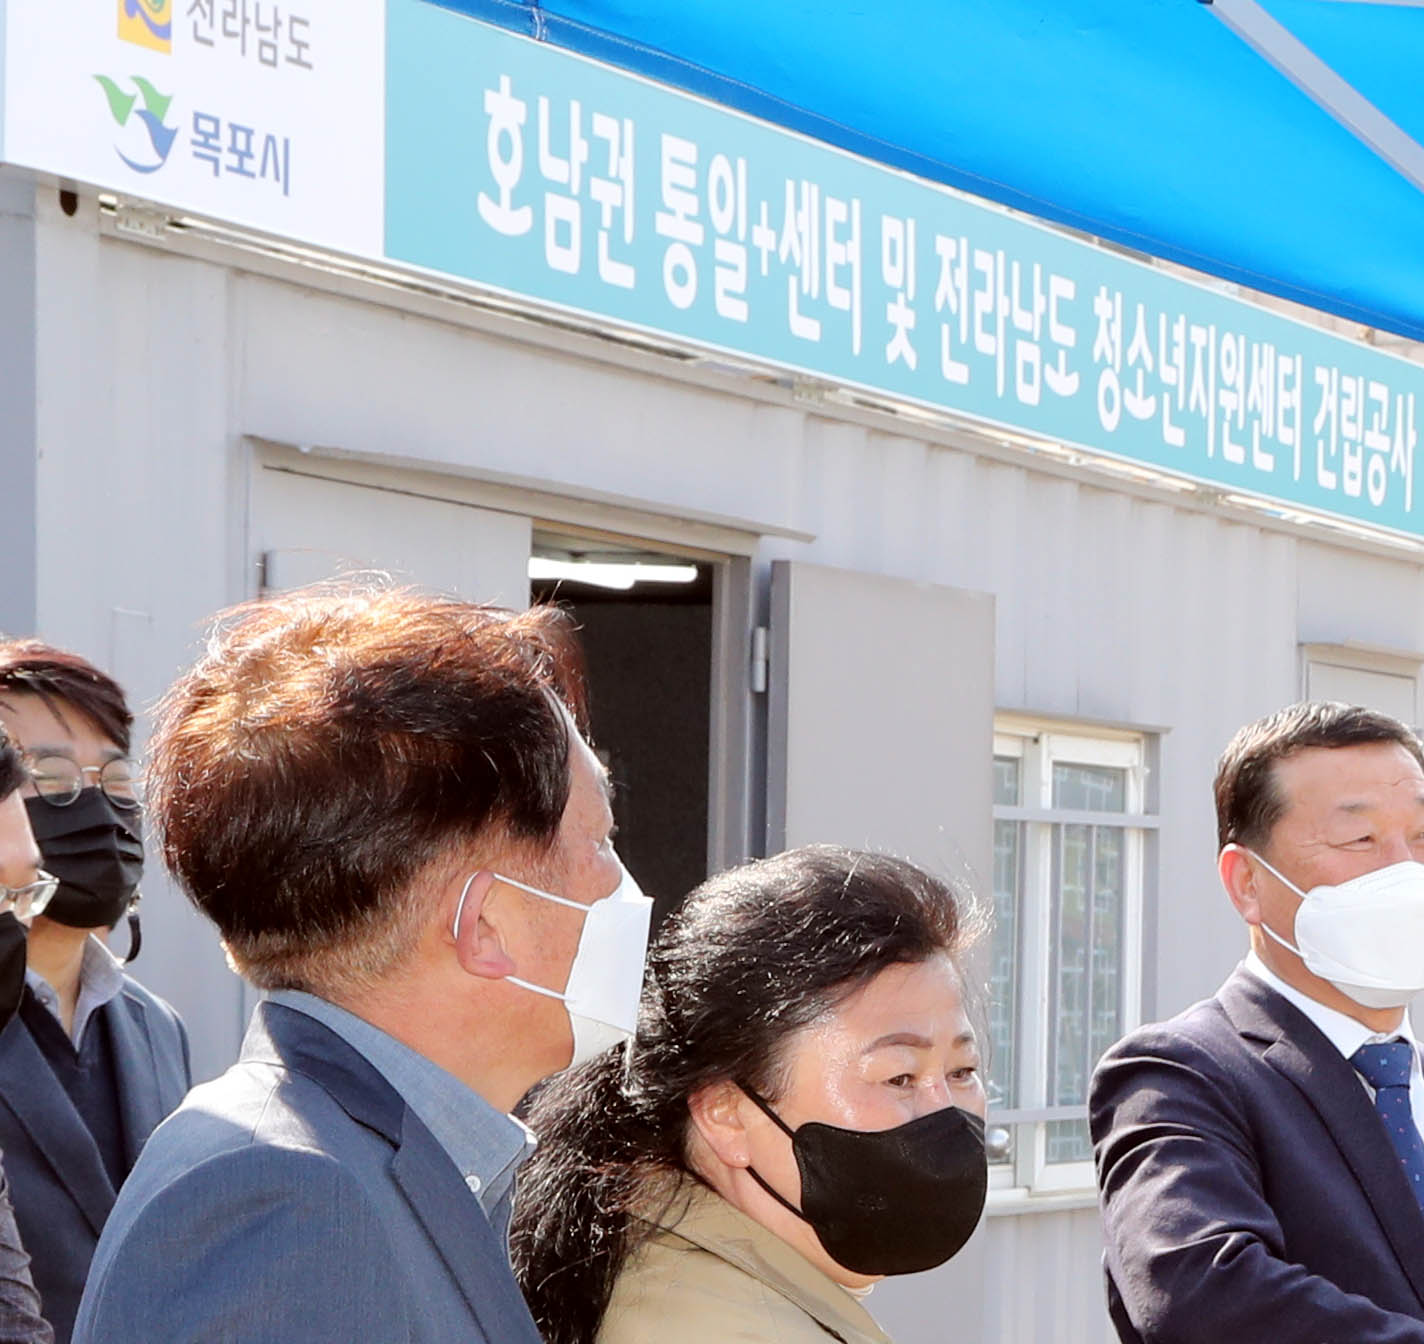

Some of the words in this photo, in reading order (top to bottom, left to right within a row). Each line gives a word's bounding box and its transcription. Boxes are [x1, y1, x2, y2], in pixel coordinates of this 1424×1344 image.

[187, 0, 314, 70] 전라남도
[190, 110, 290, 197] 목포시
[477, 75, 637, 290] 호남권
[655, 131, 862, 356] 통일+센터
[881, 211, 918, 371] 및
[934, 233, 1080, 406] 전라남도
[1093, 285, 1302, 482] 청소년지원센터
[1313, 365, 1418, 513] 건립공사
